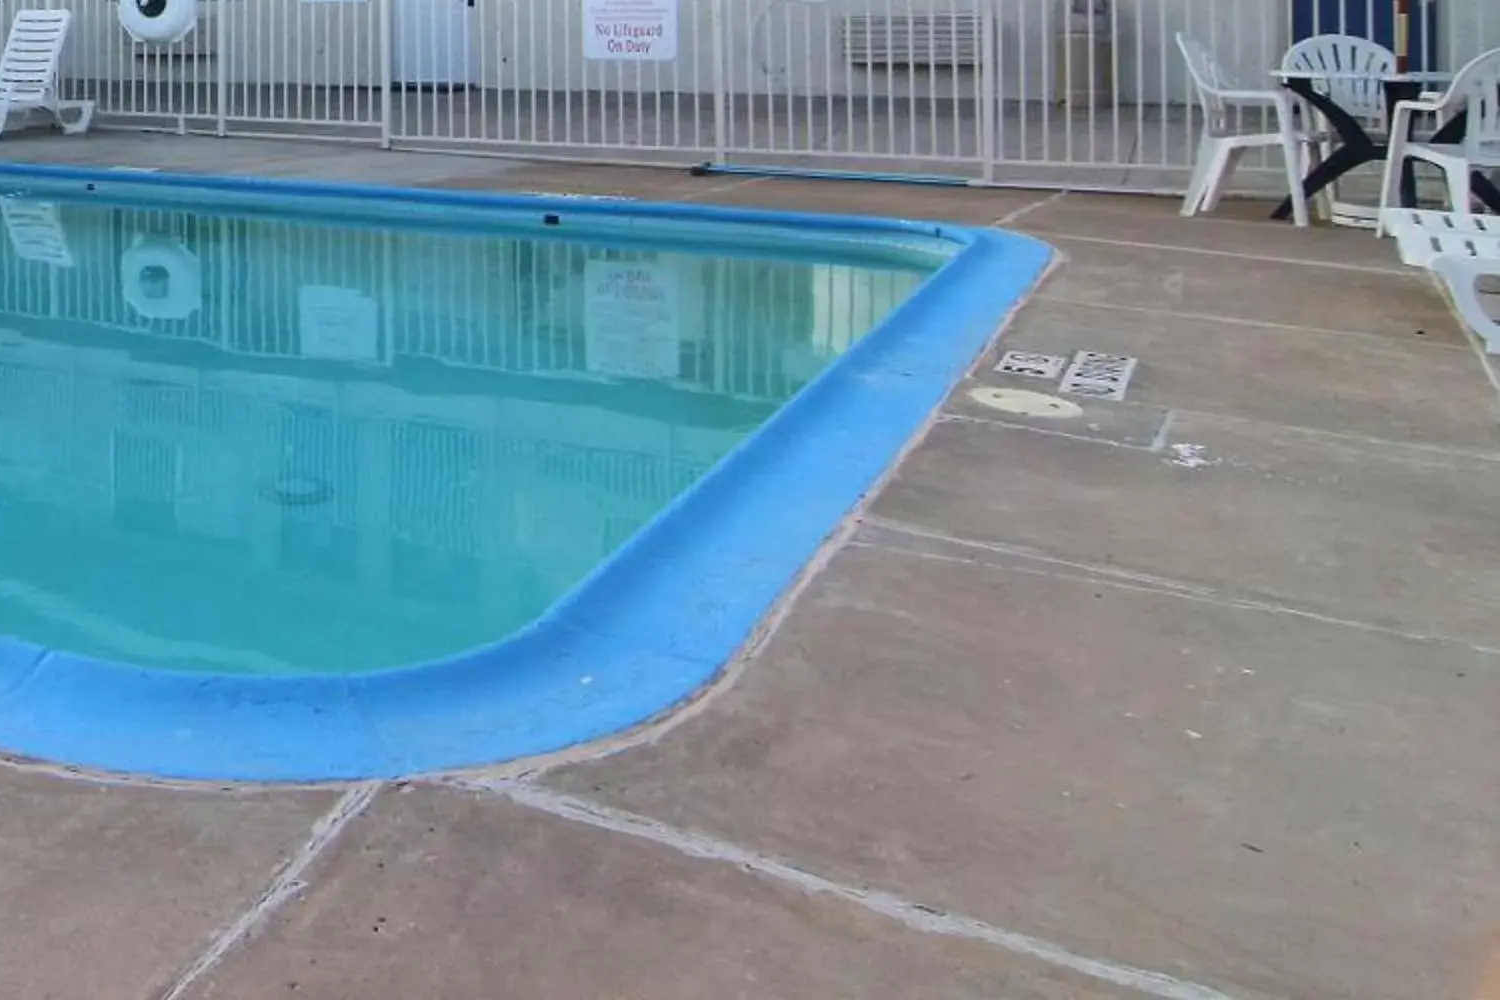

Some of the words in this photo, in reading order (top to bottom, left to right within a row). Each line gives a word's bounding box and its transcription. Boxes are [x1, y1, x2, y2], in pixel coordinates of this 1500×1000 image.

[595, 24, 610, 37] No
[613, 23, 663, 38] Lifeguard
[625, 40, 650, 55] Duty
